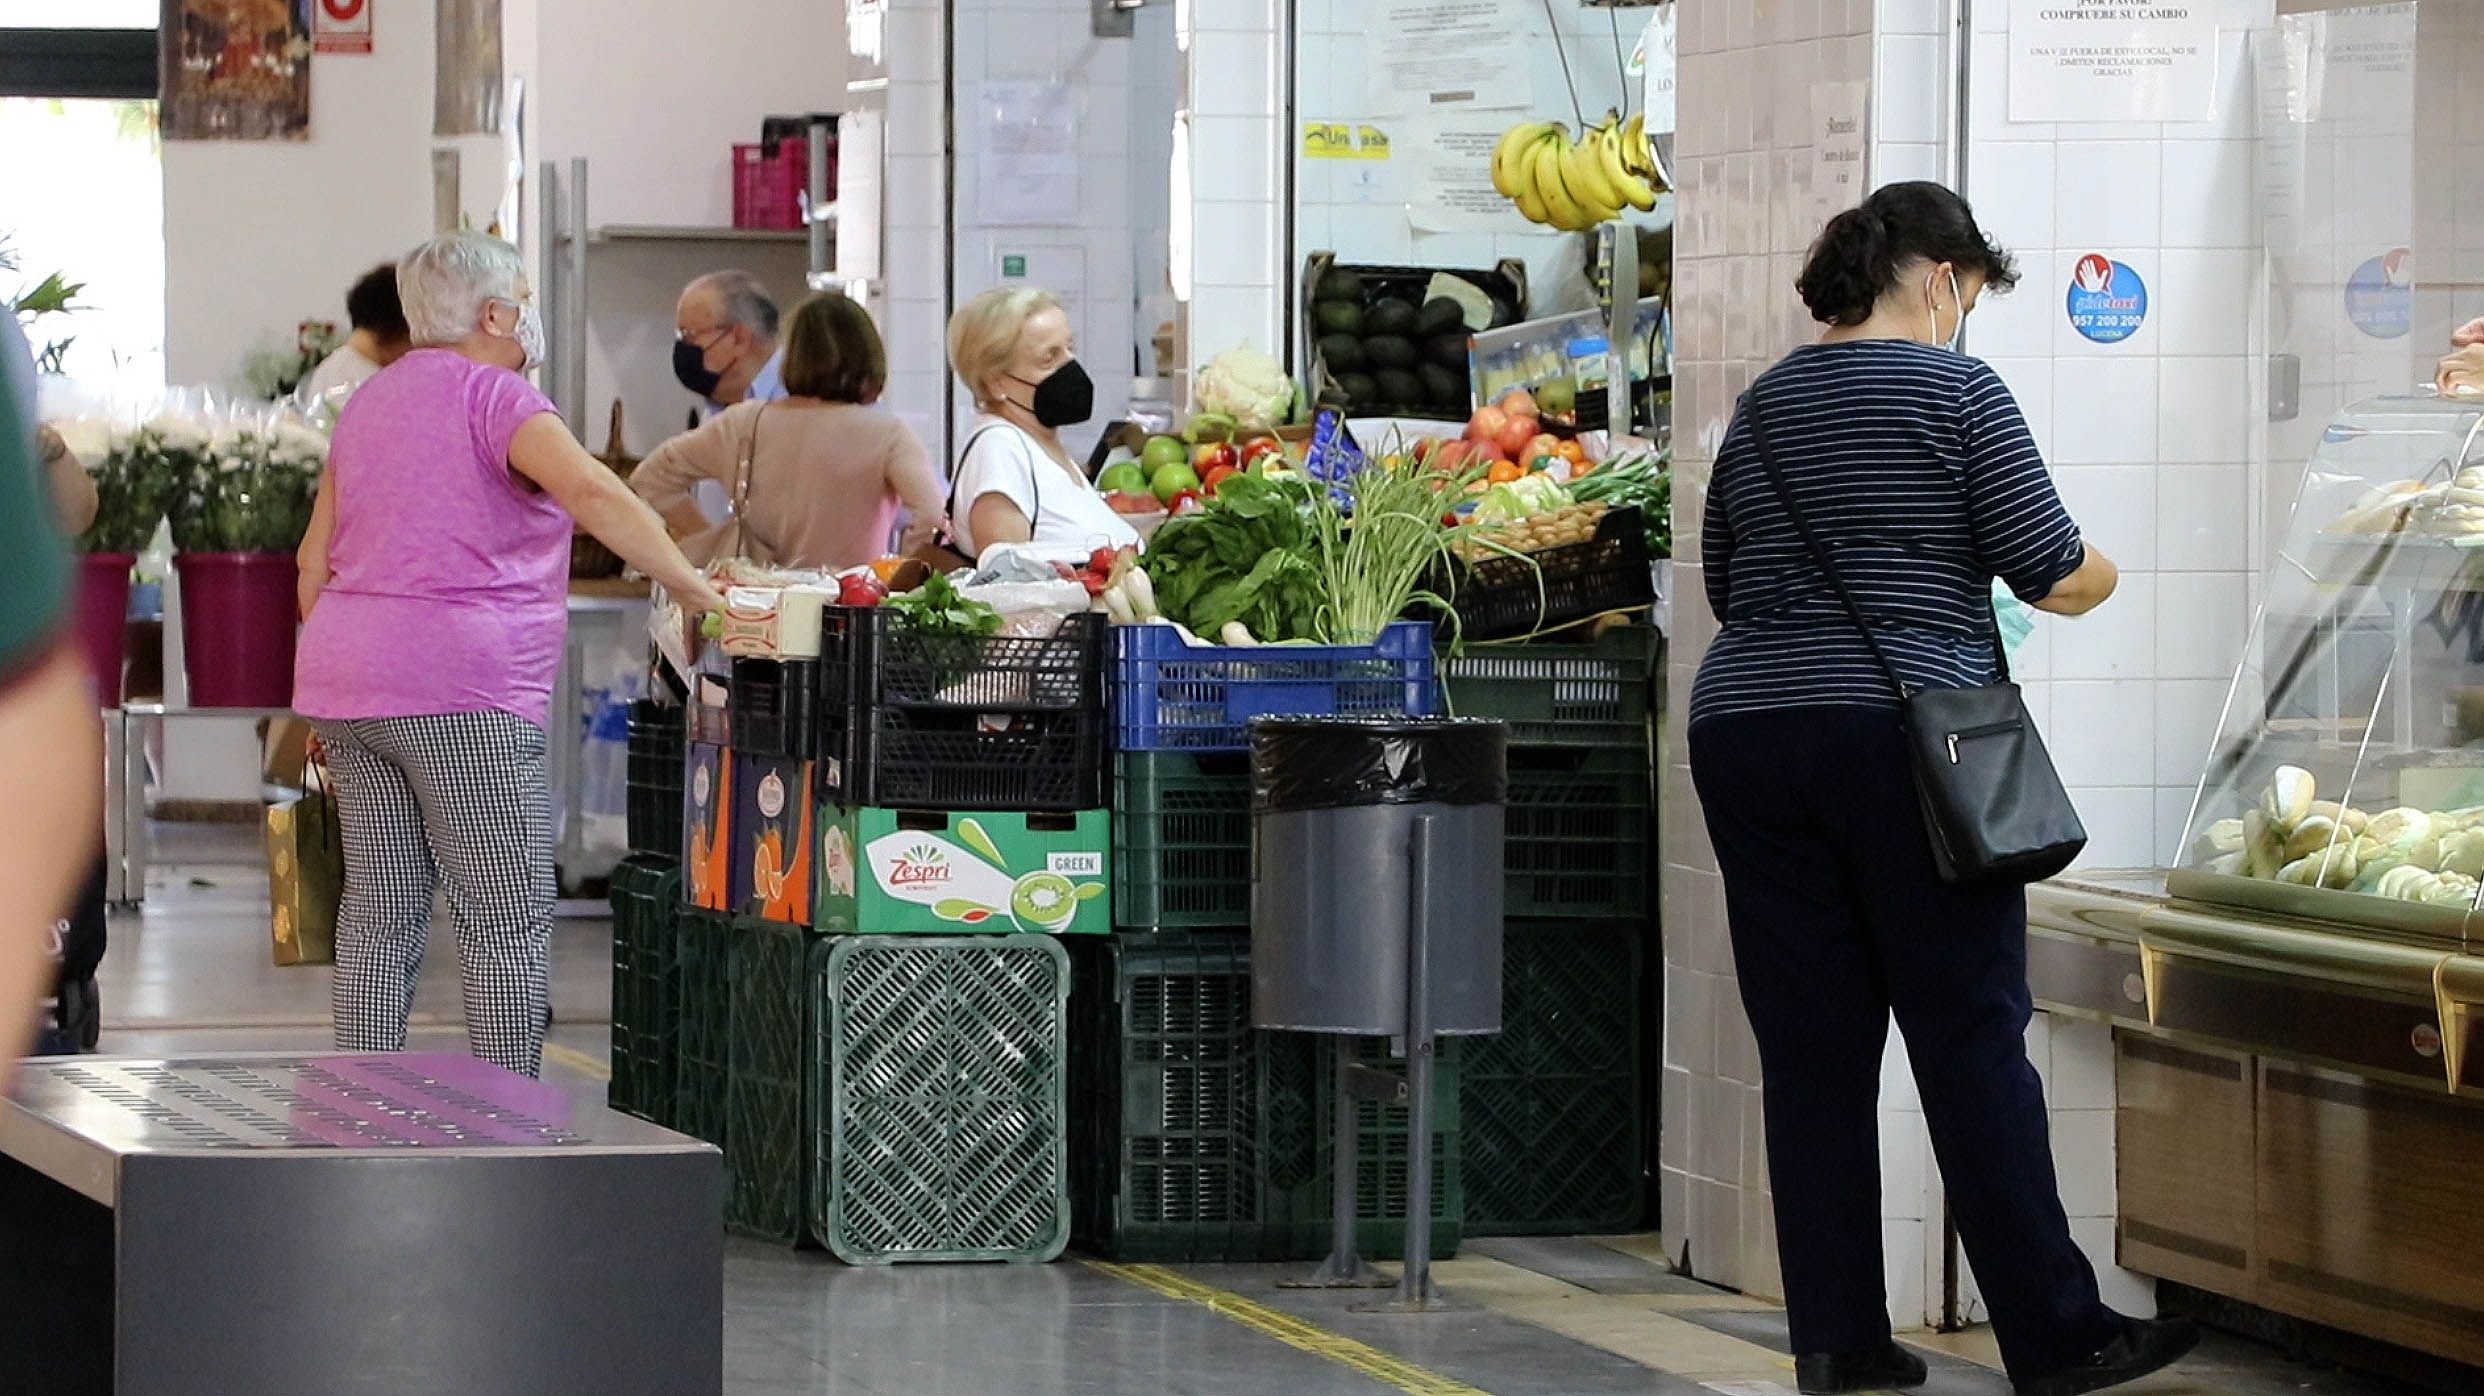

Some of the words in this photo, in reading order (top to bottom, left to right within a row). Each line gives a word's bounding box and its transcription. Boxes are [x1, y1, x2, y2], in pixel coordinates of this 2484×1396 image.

[2040, 10, 2117, 20] COMPRUEBE
[2119, 10, 2135, 20] SU
[2138, 9, 2188, 20] CAMBIO
[2030, 48, 2049, 56] UNA
[2172, 47, 2185, 55] NO
[2055, 58, 2095, 66] DMITEN
[2093, 68, 2133, 76] GRACIAS
[2073, 314, 2094, 326] 957
[2096, 314, 2118, 326] 200
[1054, 857, 1095, 871] GREEN
[889, 859, 952, 885] Zespri
